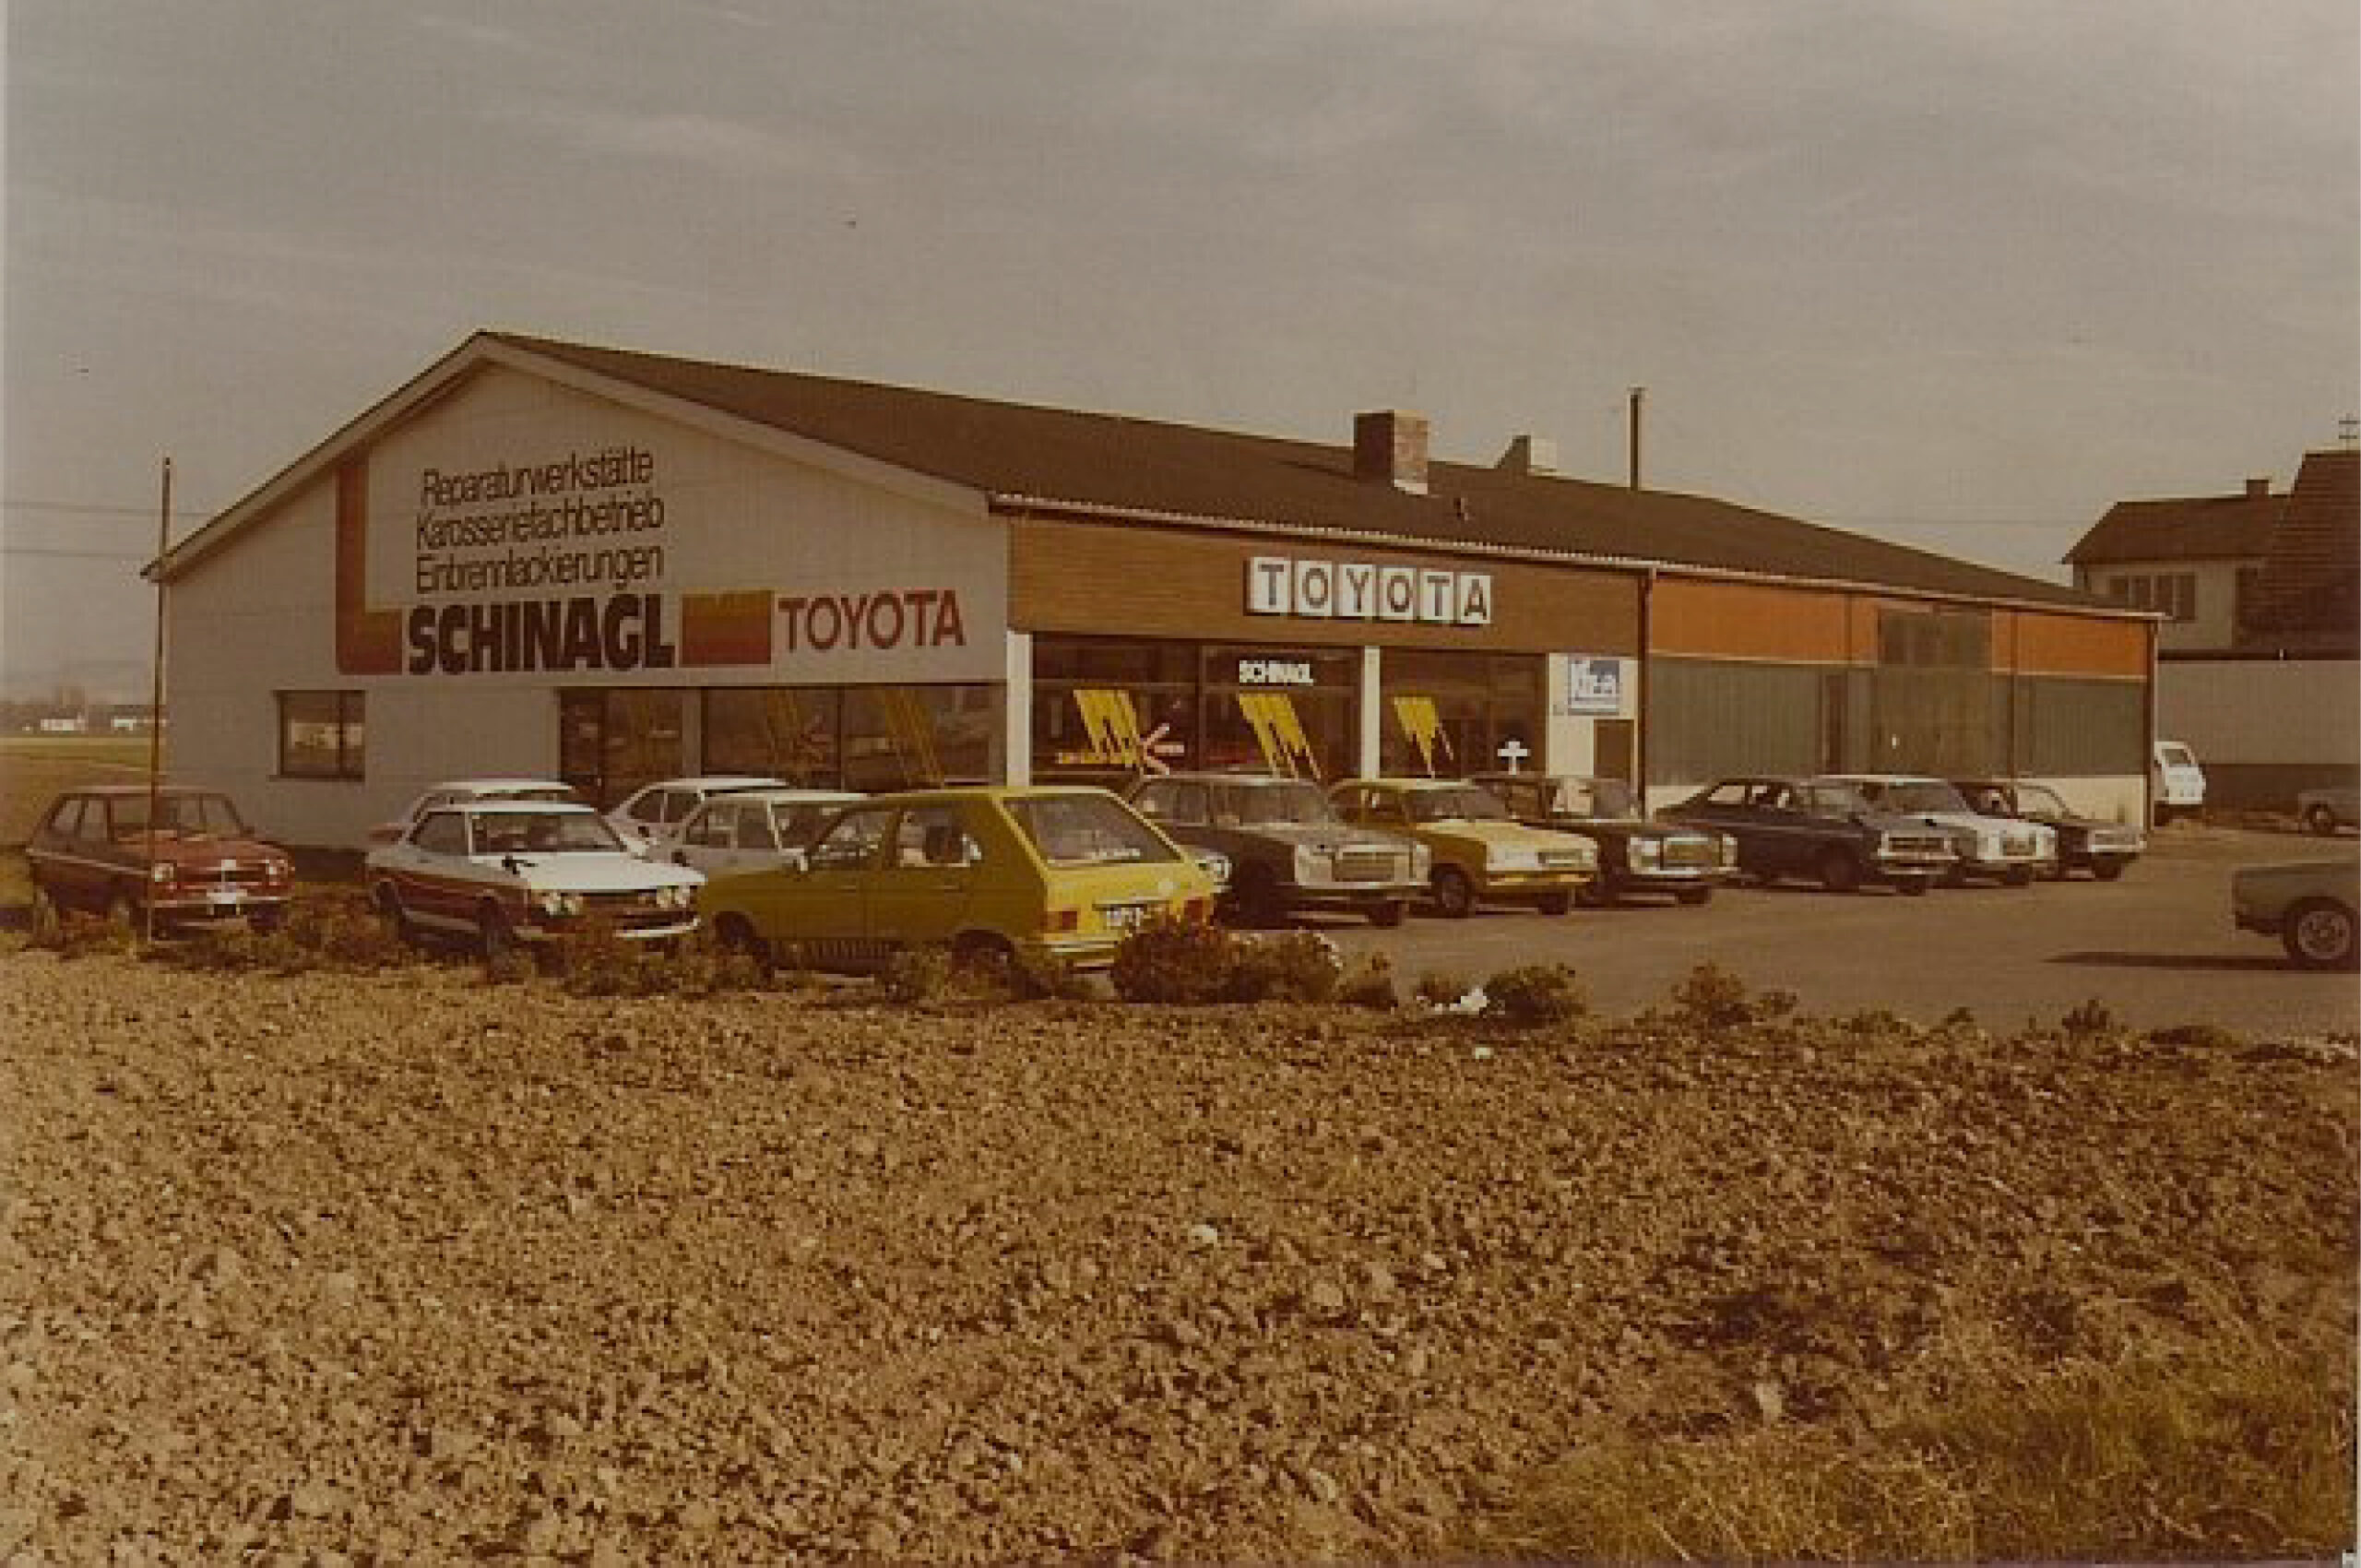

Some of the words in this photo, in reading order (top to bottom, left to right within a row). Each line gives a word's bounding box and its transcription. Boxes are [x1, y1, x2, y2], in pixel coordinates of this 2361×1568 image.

[777, 590, 967, 653] TOYOTA
[1257, 563, 1488, 617] TOYOTA
[409, 593, 675, 675] SCHINAGL
